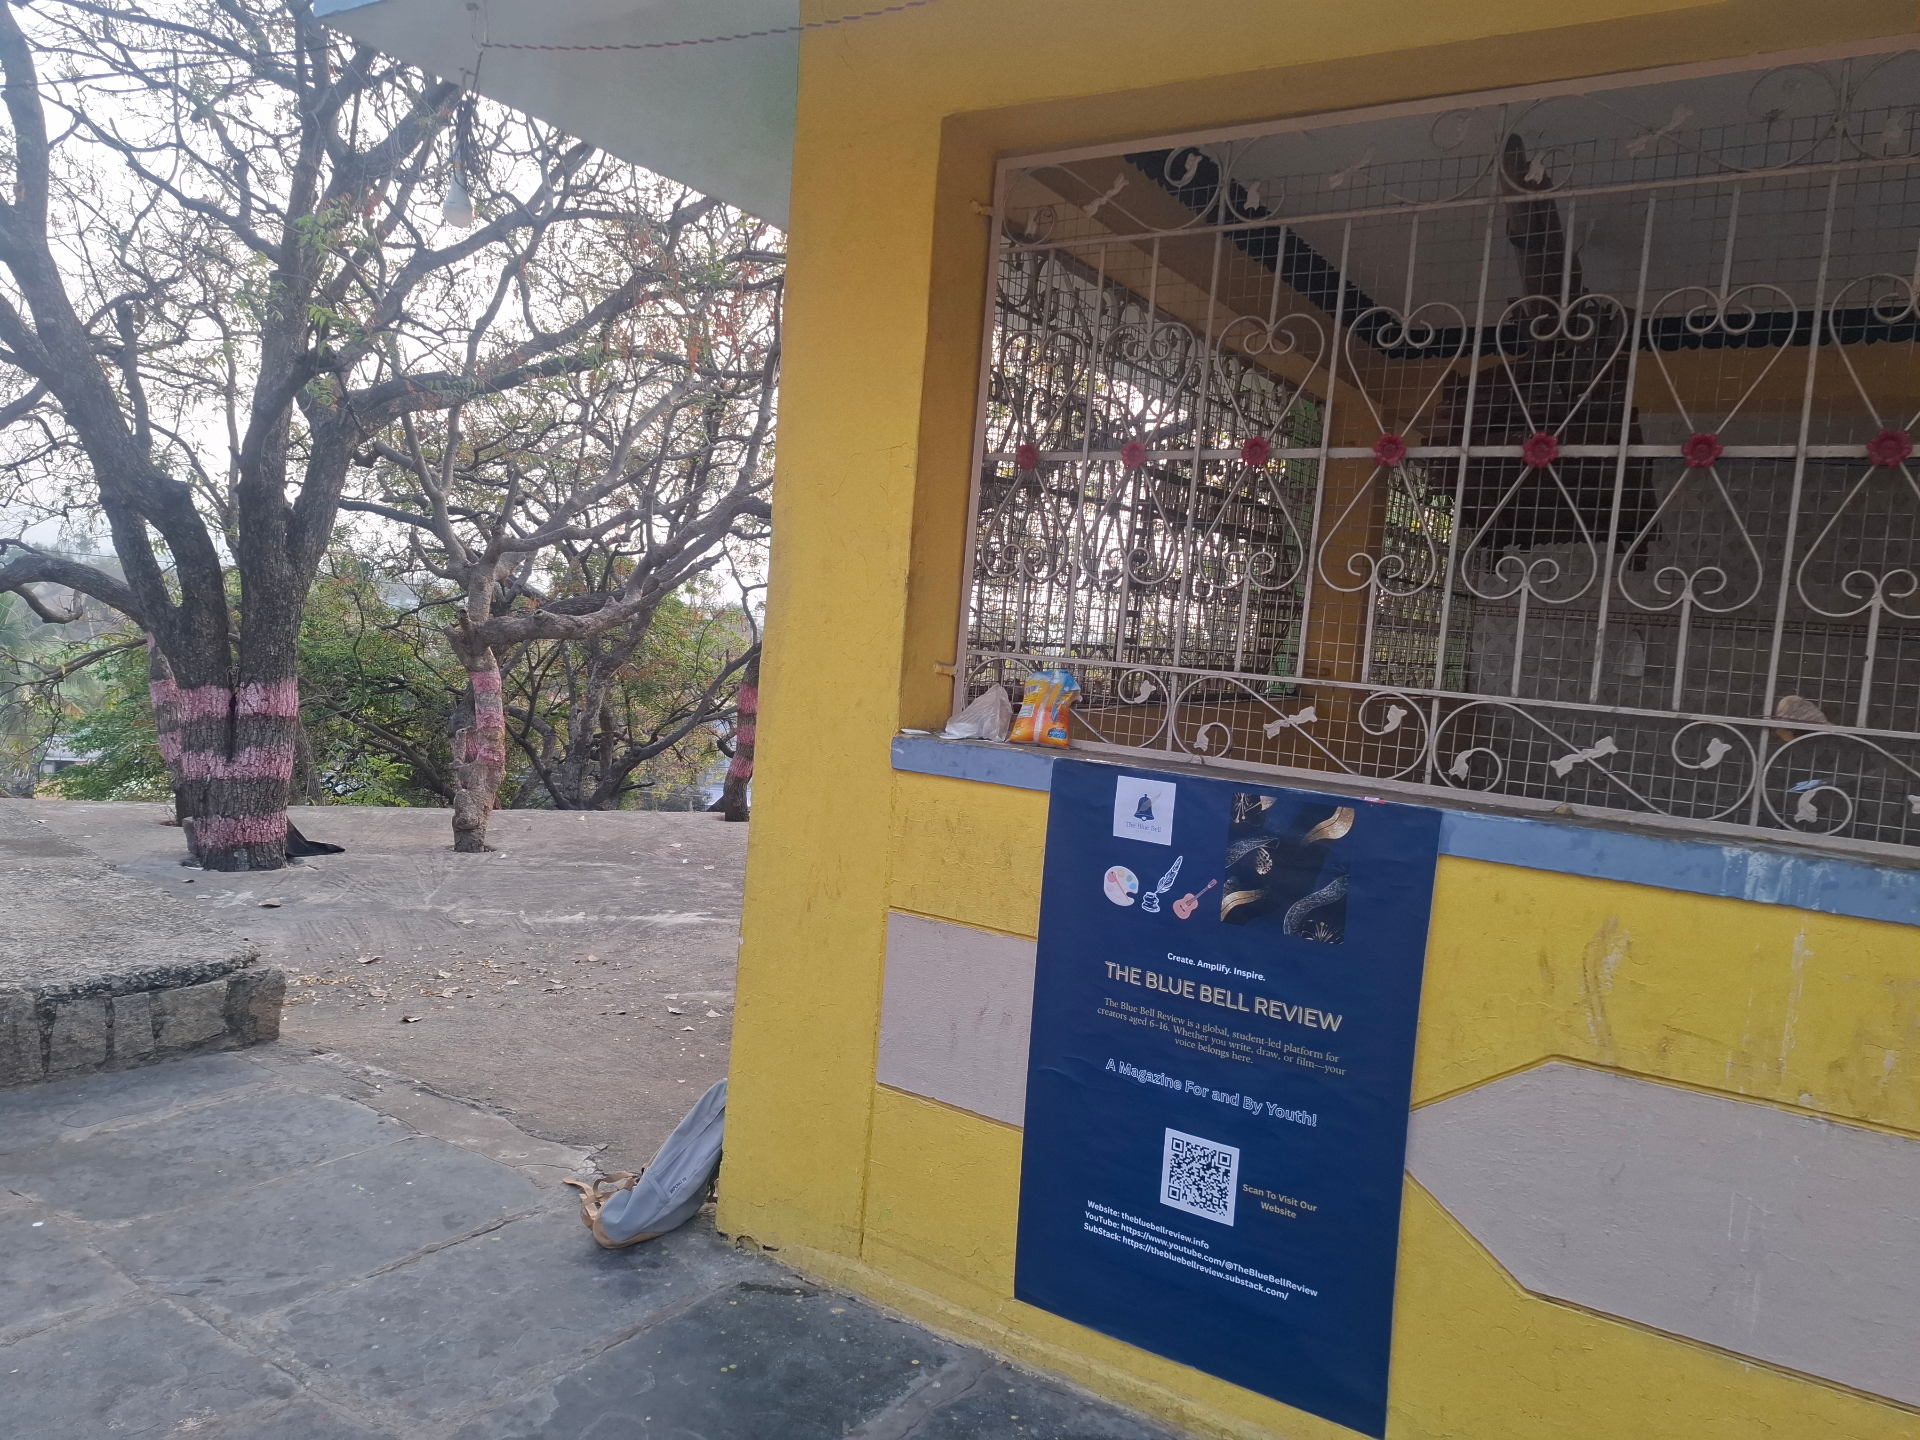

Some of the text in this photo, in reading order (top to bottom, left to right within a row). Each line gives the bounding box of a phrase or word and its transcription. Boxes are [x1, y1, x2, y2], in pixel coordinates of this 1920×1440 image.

[1167, 952, 1266, 982] Create. Amplify. Inspire.
[1105, 961, 1342, 1032] THE BLUE BELL REVIEW
[1097, 1007, 1127, 1021] creators
[1129, 1013, 1148, 1026] aged
[1173, 1023, 1209, 1042] Whether
[1211, 1034, 1227, 1046] you
[1228, 1038, 1253, 1054] write,
[1256, 1045, 1281, 1061] draw,
[1283, 1055, 1294, 1064] or
[1104, 997, 1119, 1008] The
[1120, 1001, 1138, 1013] Blue
[1140, 1006, 1155, 1017] Bell
[1157, 1010, 1185, 1025] Review
[1187, 1018, 1194, 1027] is
[1202, 1022, 1230, 1038] global,
[1232, 1030, 1281, 1050] student-led
[1283, 1040, 1323, 1059] platform
[1325, 1051, 1339, 1063] for
[1174, 1037, 1253, 1064] voice belongs here.
[1105, 1058, 1317, 1128] A Magazine For and By Youth!
[1087, 1200, 1210, 1250] Website: thebluebellreview.info
[1242, 1183, 1318, 1213] Scan To Visit Our
[1260, 1201, 1296, 1219] Website
[1084, 1211, 1318, 1297] YouTube: https://www.youtube.com/@TheBlueBellReview
[1084, 1222, 1289, 1300] SubStack: https://thebluebellreview.substack.com/
